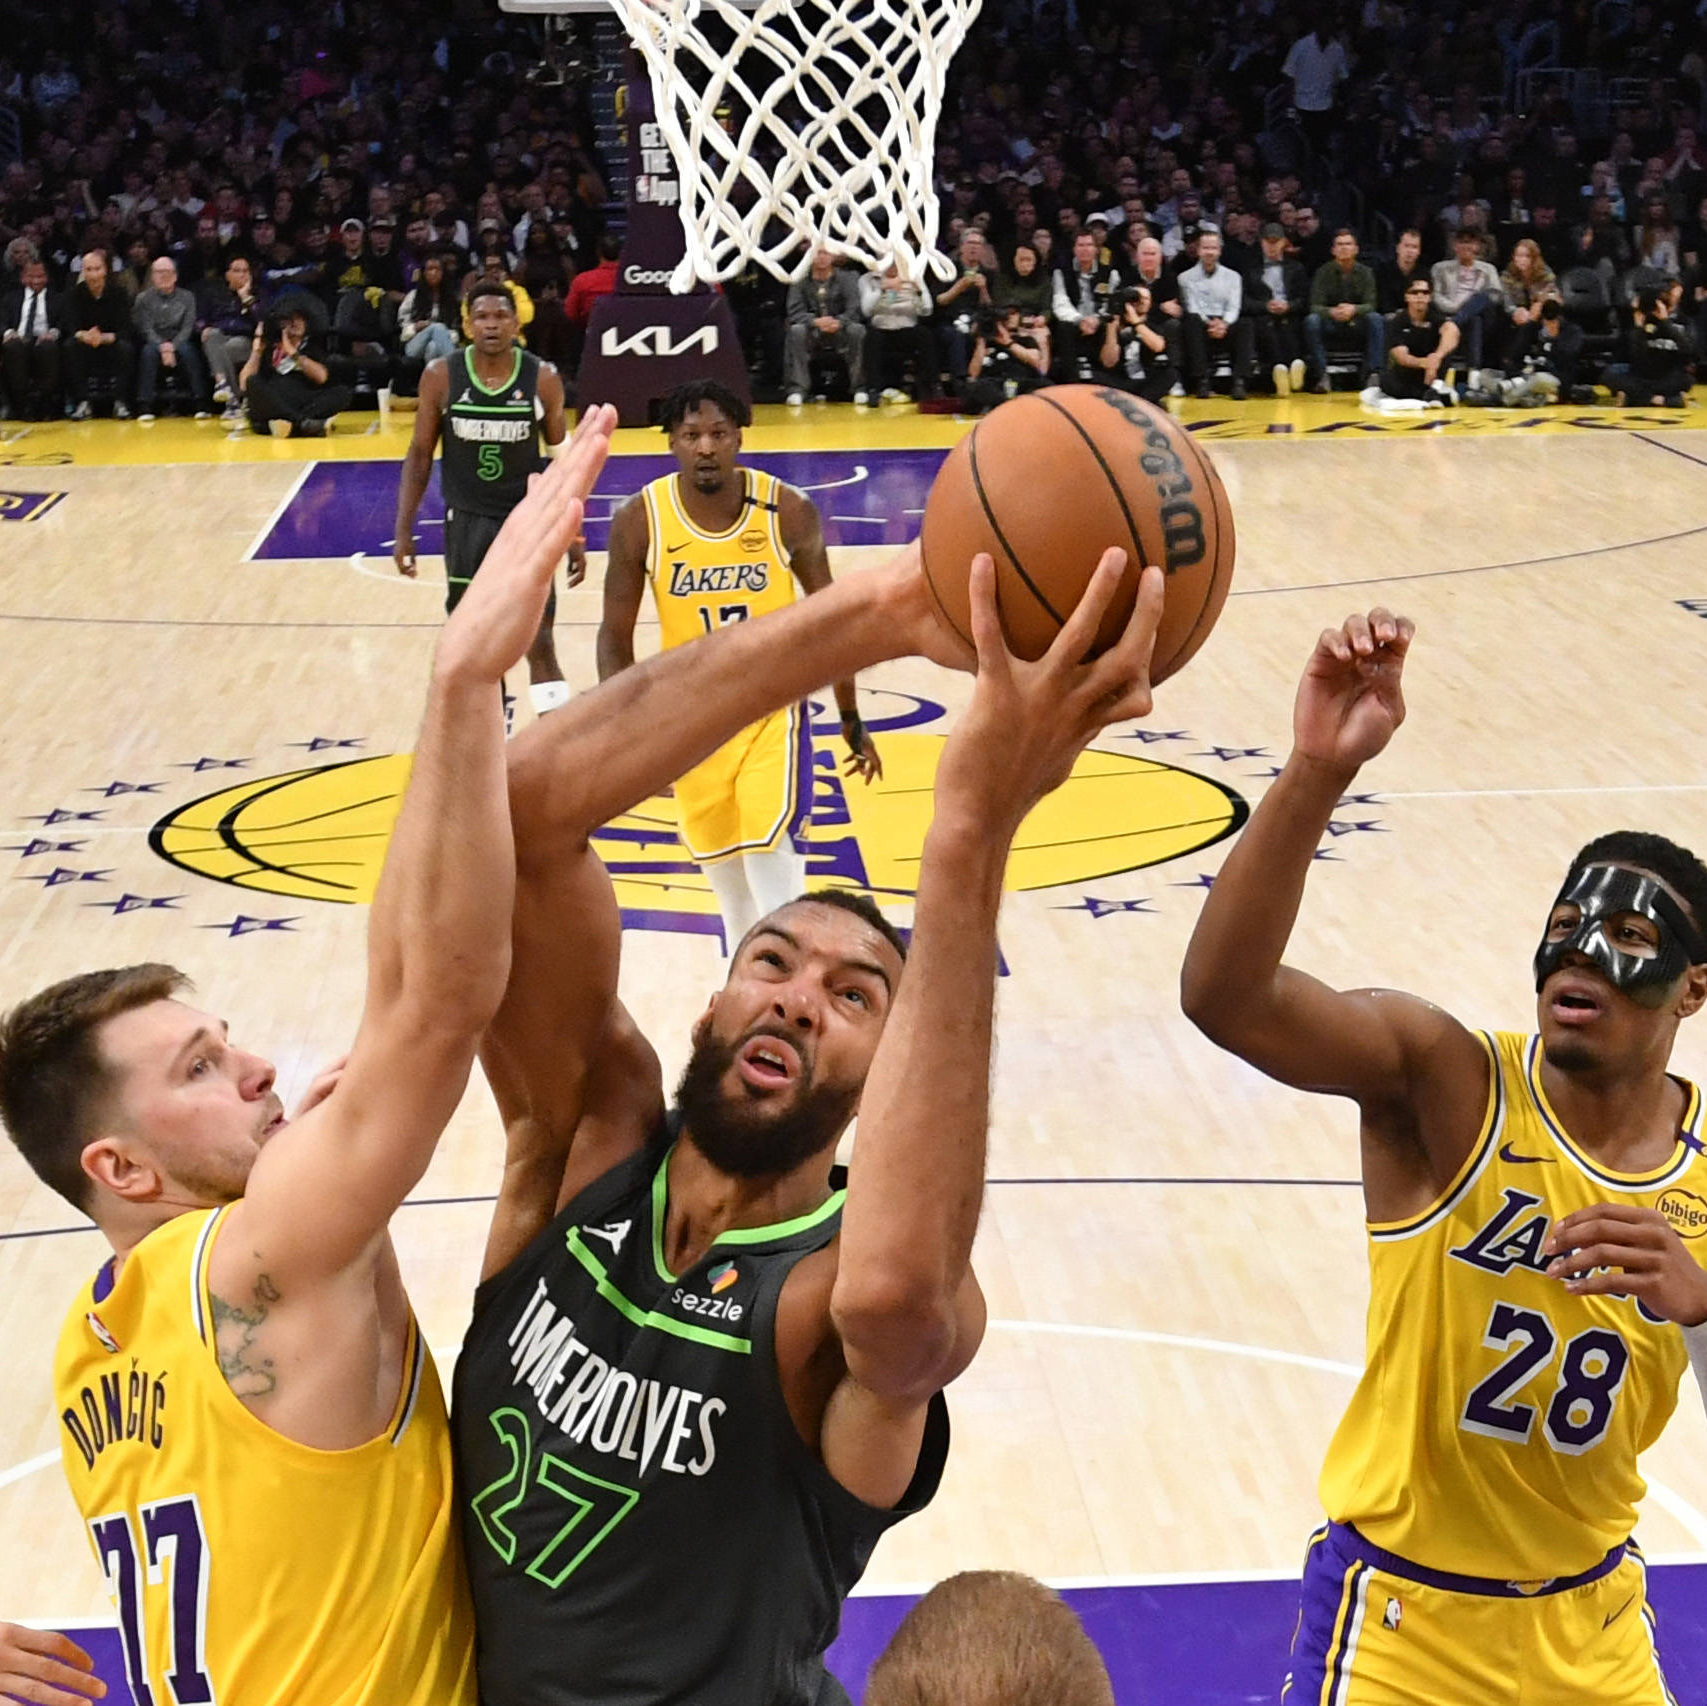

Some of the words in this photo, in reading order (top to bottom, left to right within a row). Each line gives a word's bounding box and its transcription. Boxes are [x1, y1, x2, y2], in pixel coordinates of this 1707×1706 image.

[623, 264, 676, 288] Goog
[477, 444, 504, 481] 5
[667, 562, 768, 598] LAKERS
[671, 1286, 744, 1323] sezzle
[1458, 1299, 1630, 1457] 28
[60, 1357, 168, 1473] DONČIĆ
[470, 1406, 641, 1590] 27
